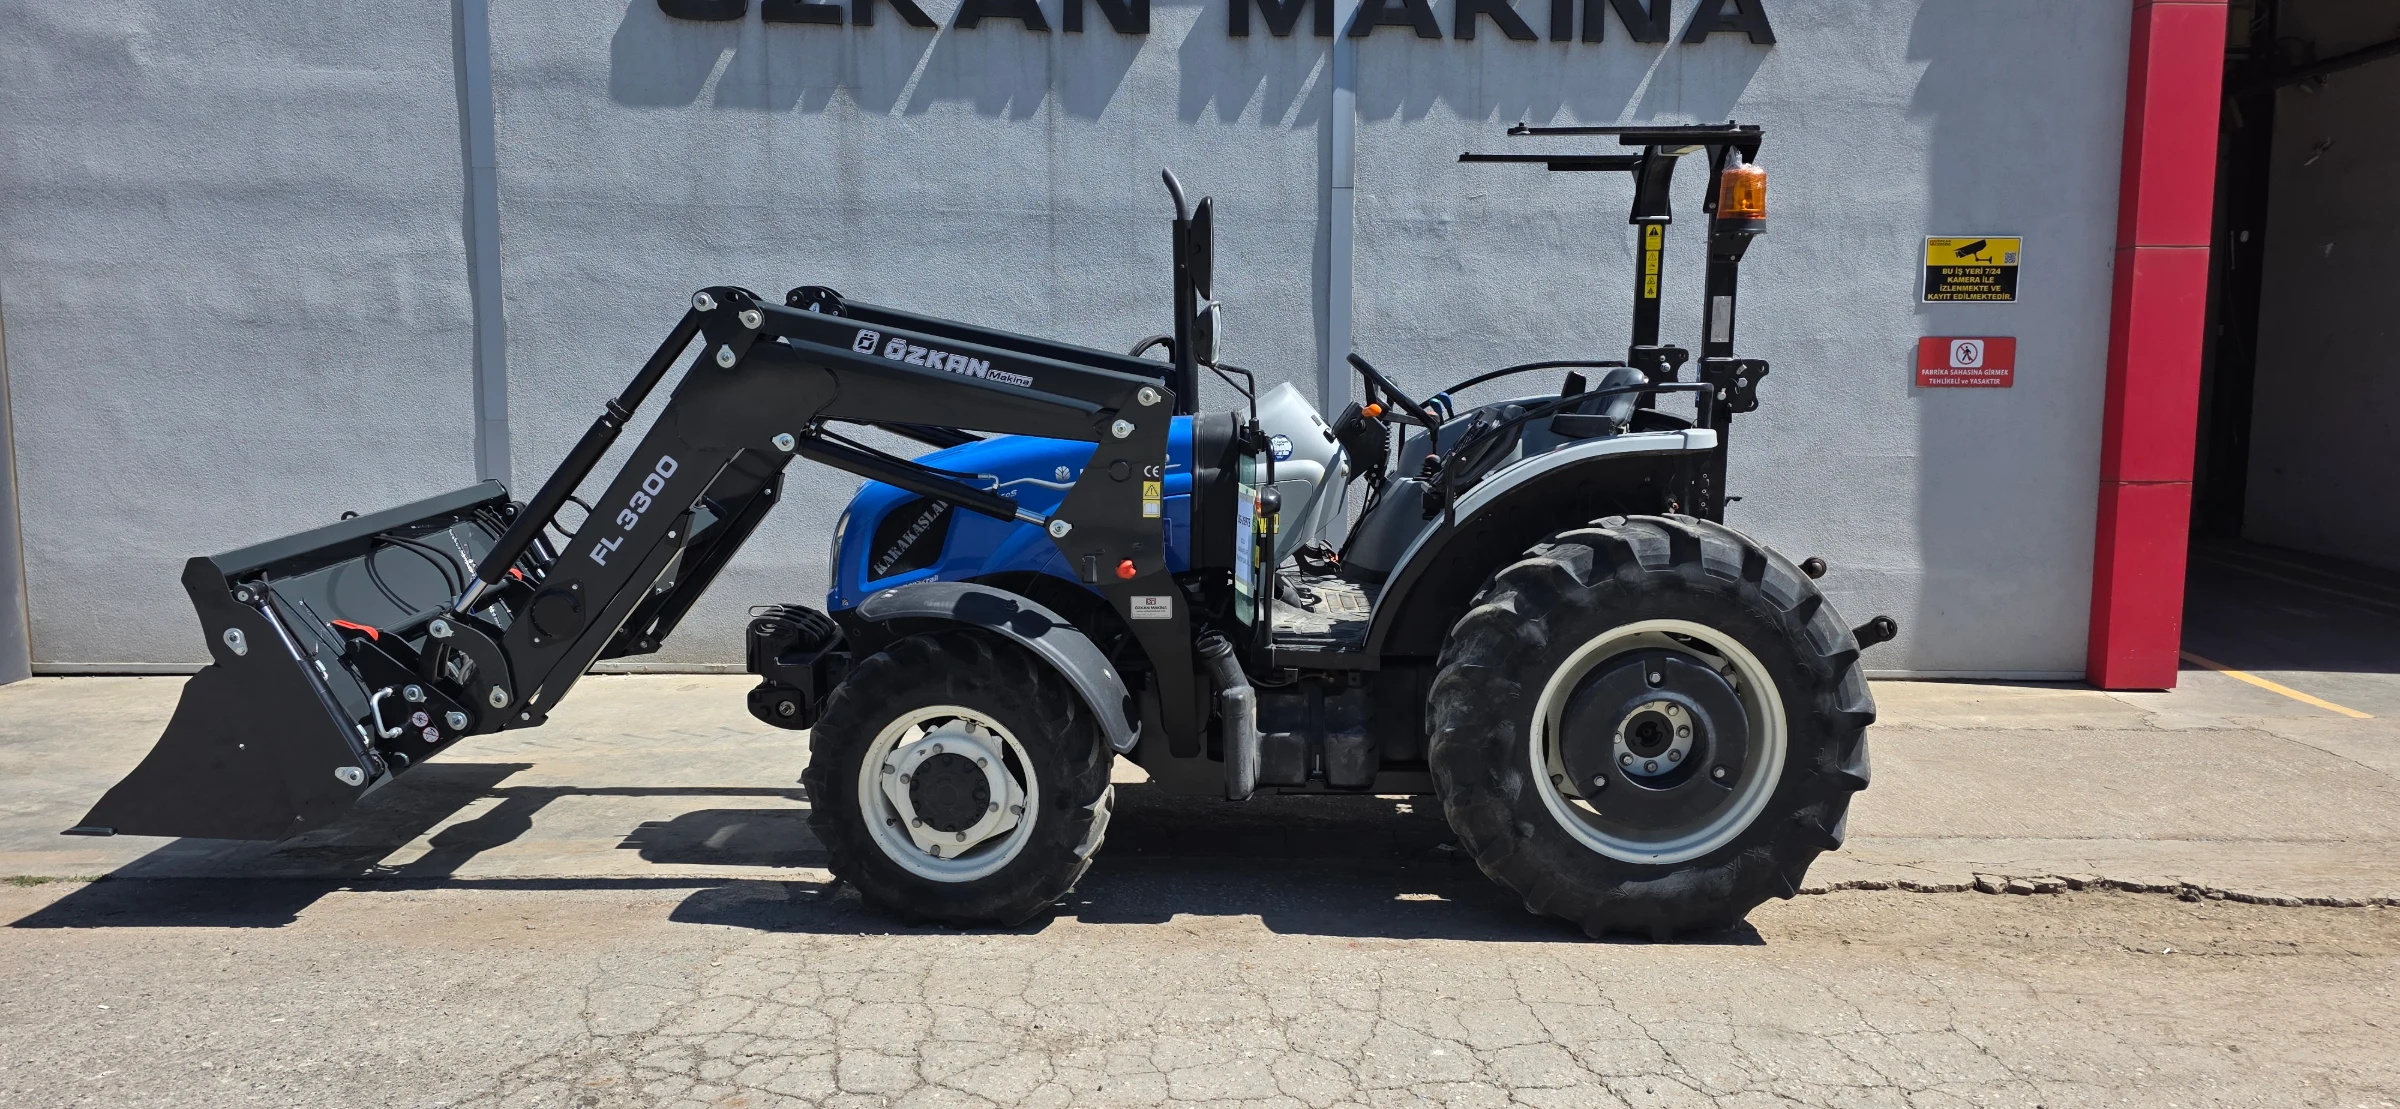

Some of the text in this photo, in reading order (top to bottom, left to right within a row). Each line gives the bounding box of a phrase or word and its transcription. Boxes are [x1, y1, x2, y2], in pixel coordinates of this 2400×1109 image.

[1955, 266, 1963, 276] İŞ
[1965, 266, 1983, 274] YERİ
[884, 337, 1030, 386] ÖZKAN Makina
[1922, 368, 1948, 376] FABRİKA
[1984, 368, 2008, 376] GİRMEK
[588, 455, 678, 566] FL 3300
